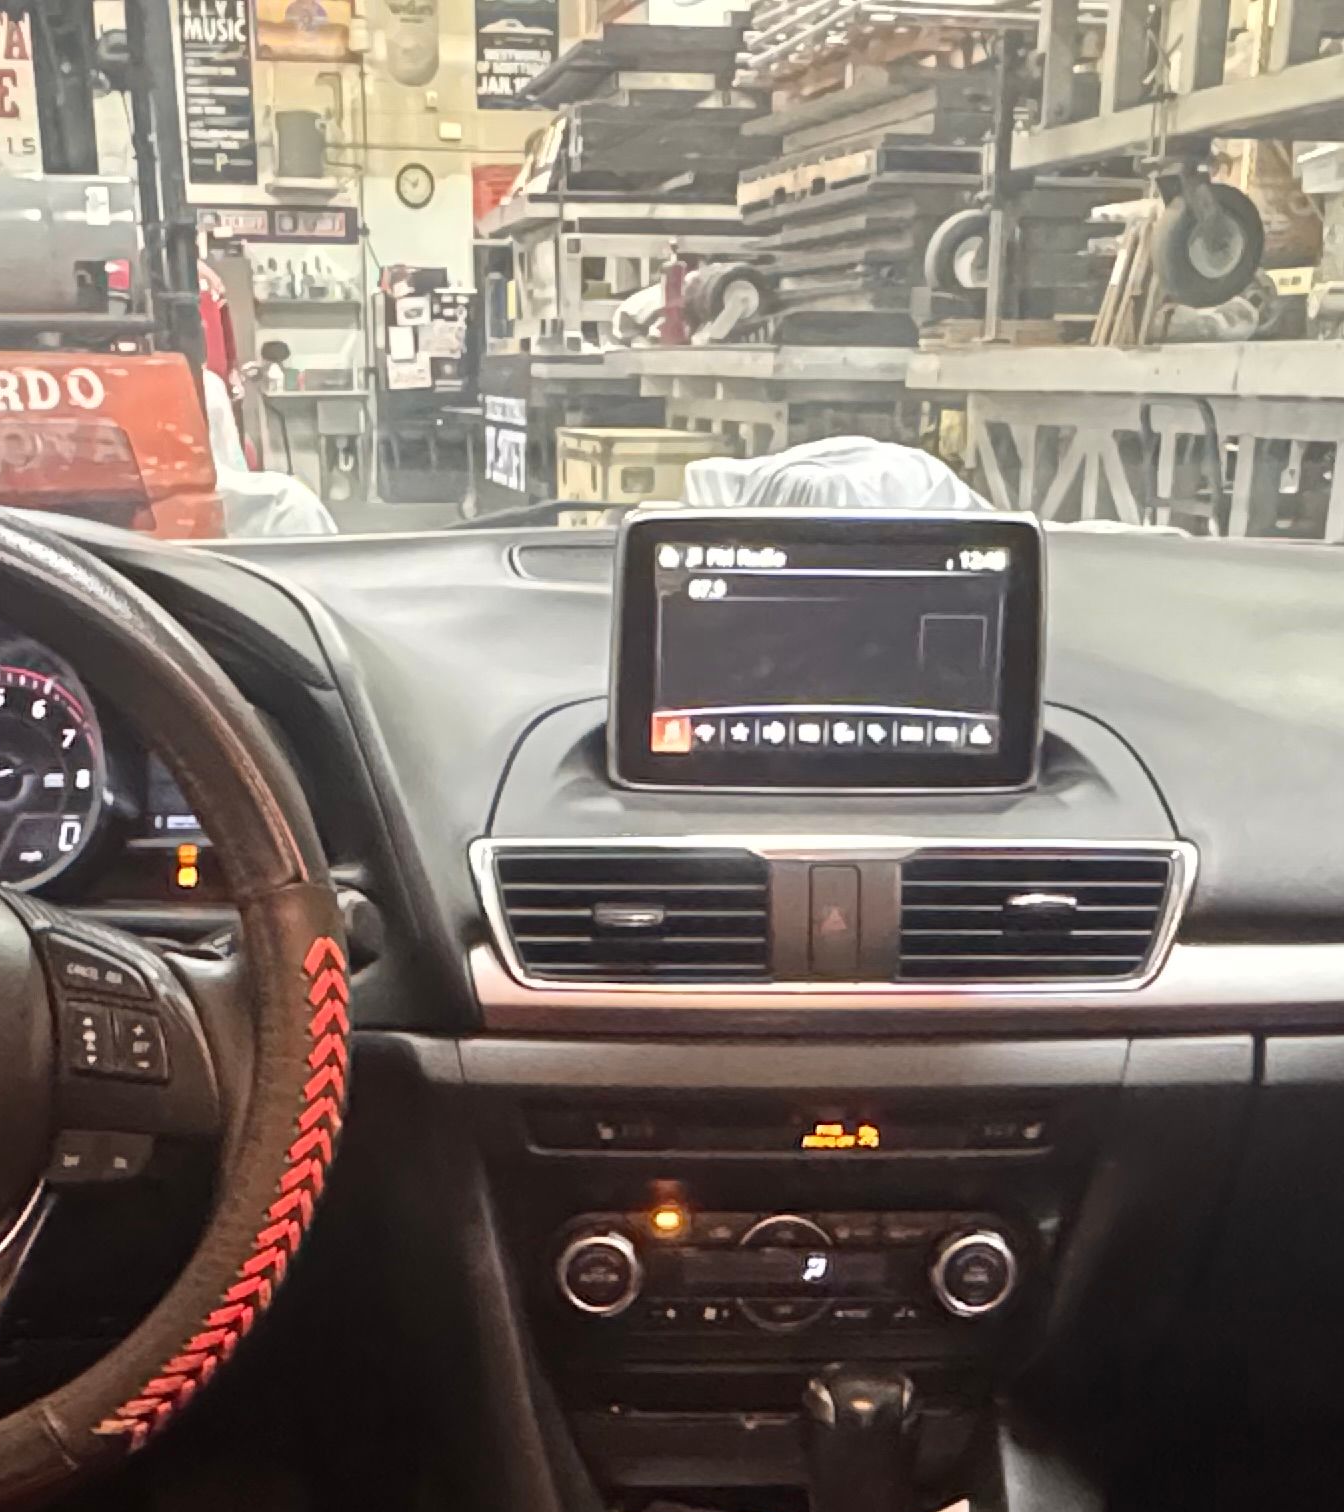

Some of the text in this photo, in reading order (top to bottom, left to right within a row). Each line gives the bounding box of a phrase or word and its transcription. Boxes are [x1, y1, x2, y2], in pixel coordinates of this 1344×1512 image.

[183, 17, 247, 42] MUSIC
[6, 137, 36, 155] 15
[31, 699, 47, 719] 6
[61, 728, 76, 749] 7
